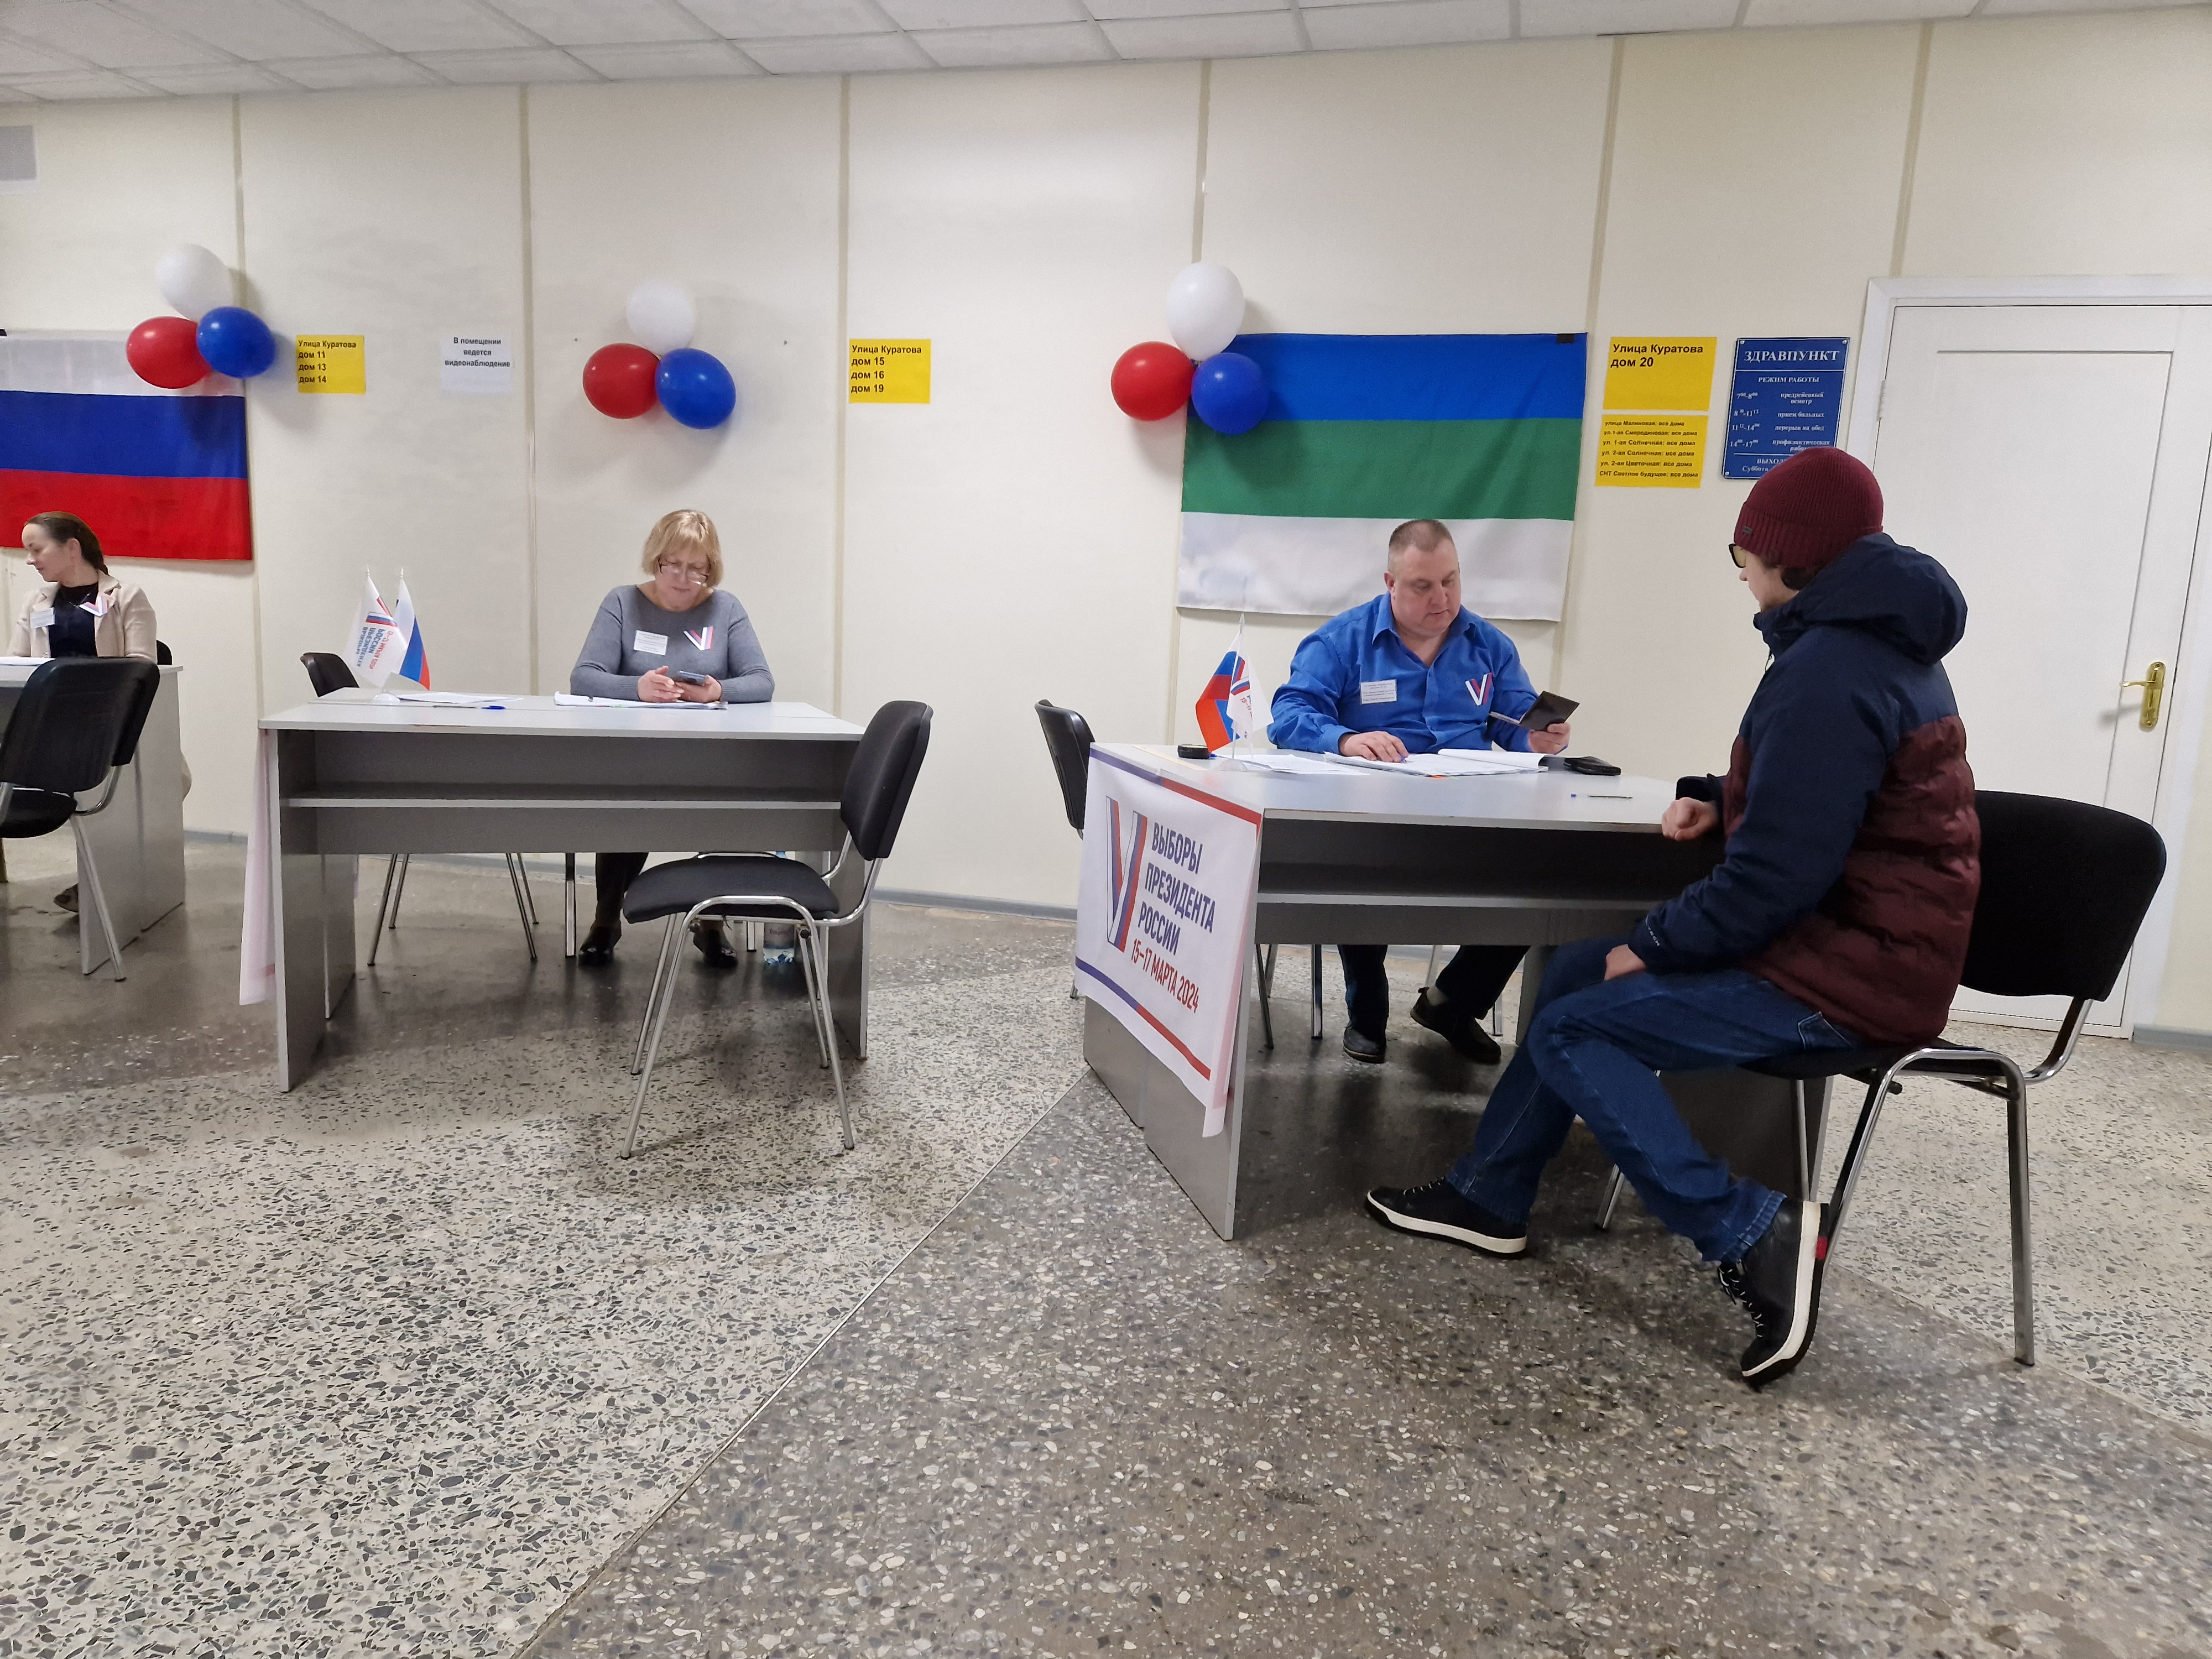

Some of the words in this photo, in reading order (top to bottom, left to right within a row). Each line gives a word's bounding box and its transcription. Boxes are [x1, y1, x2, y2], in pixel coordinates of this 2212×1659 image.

[322, 340, 356, 349] Куратова
[1613, 344, 1647, 354] Улица
[1651, 344, 1703, 355] Куратова
[852, 345, 878, 354] Улица
[881, 345, 922, 355] Куратова
[1744, 350, 1839, 363] ЗДРАВПУНКТ
[445, 359, 510, 368] видеонаблюдение
[851, 358, 871, 367] дом
[874, 357, 885, 365] 15
[1610, 359, 1636, 368] дом
[1640, 357, 1653, 367] 20
[317, 375, 327, 383] 14
[851, 372, 870, 380] дом
[874, 371, 884, 379] 16
[851, 385, 870, 394] дом
[873, 384, 884, 392] 19
[1151, 822, 1203, 874] ВЫБОРЫ
[1145, 862, 1215, 934] ПРЕЗИДЕНТА
[1138, 901, 1181, 956] РОССИИ
[1150, 953, 1178, 997] МАРТА
[1176, 975, 1199, 1014] 2024
